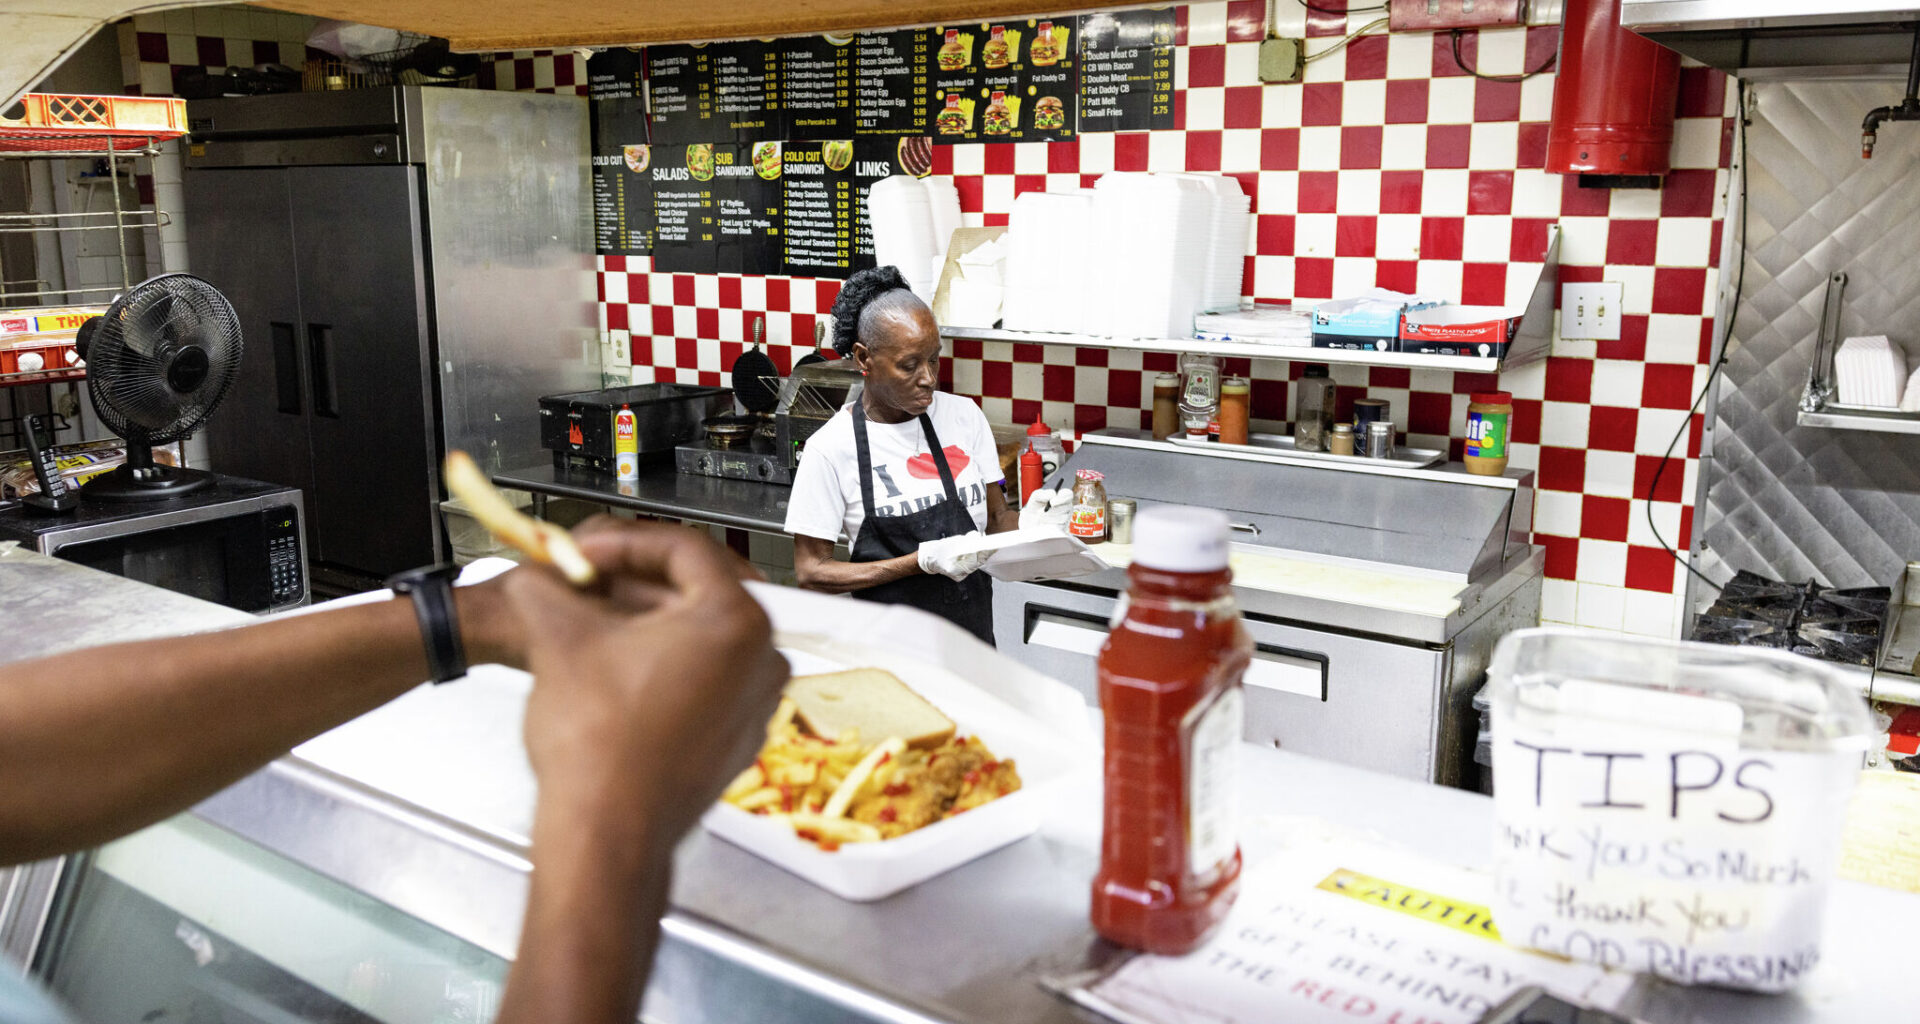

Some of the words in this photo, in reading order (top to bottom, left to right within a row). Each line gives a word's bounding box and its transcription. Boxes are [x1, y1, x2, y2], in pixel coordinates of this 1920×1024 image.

[878, 36, 888, 45] Egg
[860, 48, 883, 56] Sausage
[883, 46, 894, 55] Egg
[1088, 52, 1109, 60] Double
[1111, 51, 1127, 59] Meat
[878, 56, 903, 65] Sandwich
[1098, 62, 1112, 71] With
[1114, 62, 1134, 70] Bacon
[1154, 59, 1169, 68] 6.99
[883, 67, 910, 75] Sandwich
[873, 78, 884, 87] Egg
[1041, 74, 1057, 82] Daddy
[1088, 75, 1109, 83] Double
[1111, 74, 1127, 82] Meat
[861, 89, 877, 98] Turkey
[878, 88, 888, 97] Egg
[1088, 86, 1098, 95] Fat
[1099, 85, 1119, 95] Daddy
[1156, 82, 1170, 91] 7.99
[861, 99, 877, 108] Turkey
[895, 98, 906, 107] Egg
[1102, 97, 1116, 105] Melt
[1154, 94, 1168, 103] 5.99
[861, 109, 878, 117] Salami
[879, 109, 889, 118] Egg
[1088, 109, 1105, 117] Small
[1107, 108, 1123, 116] Fries
[1153, 106, 1168, 114] 2.75
[593, 156, 609, 166] COLD
[610, 156, 623, 165] CUT
[716, 153, 733, 165] SUB
[784, 152, 804, 162] COLD
[806, 151, 820, 161] CUT
[716, 166, 754, 176] SANDWICH
[784, 164, 824, 174] SANDWICH
[856, 161, 890, 176] LINKS
[653, 168, 689, 181] SALADS
[618, 424, 632, 434] PAM
[872, 464, 902, 498] I
[1513, 739, 1774, 824] TIPS
[1423, 949, 1517, 987] STAY
[1208, 950, 1276, 983] THE
[1290, 978, 1378, 1018] RED
